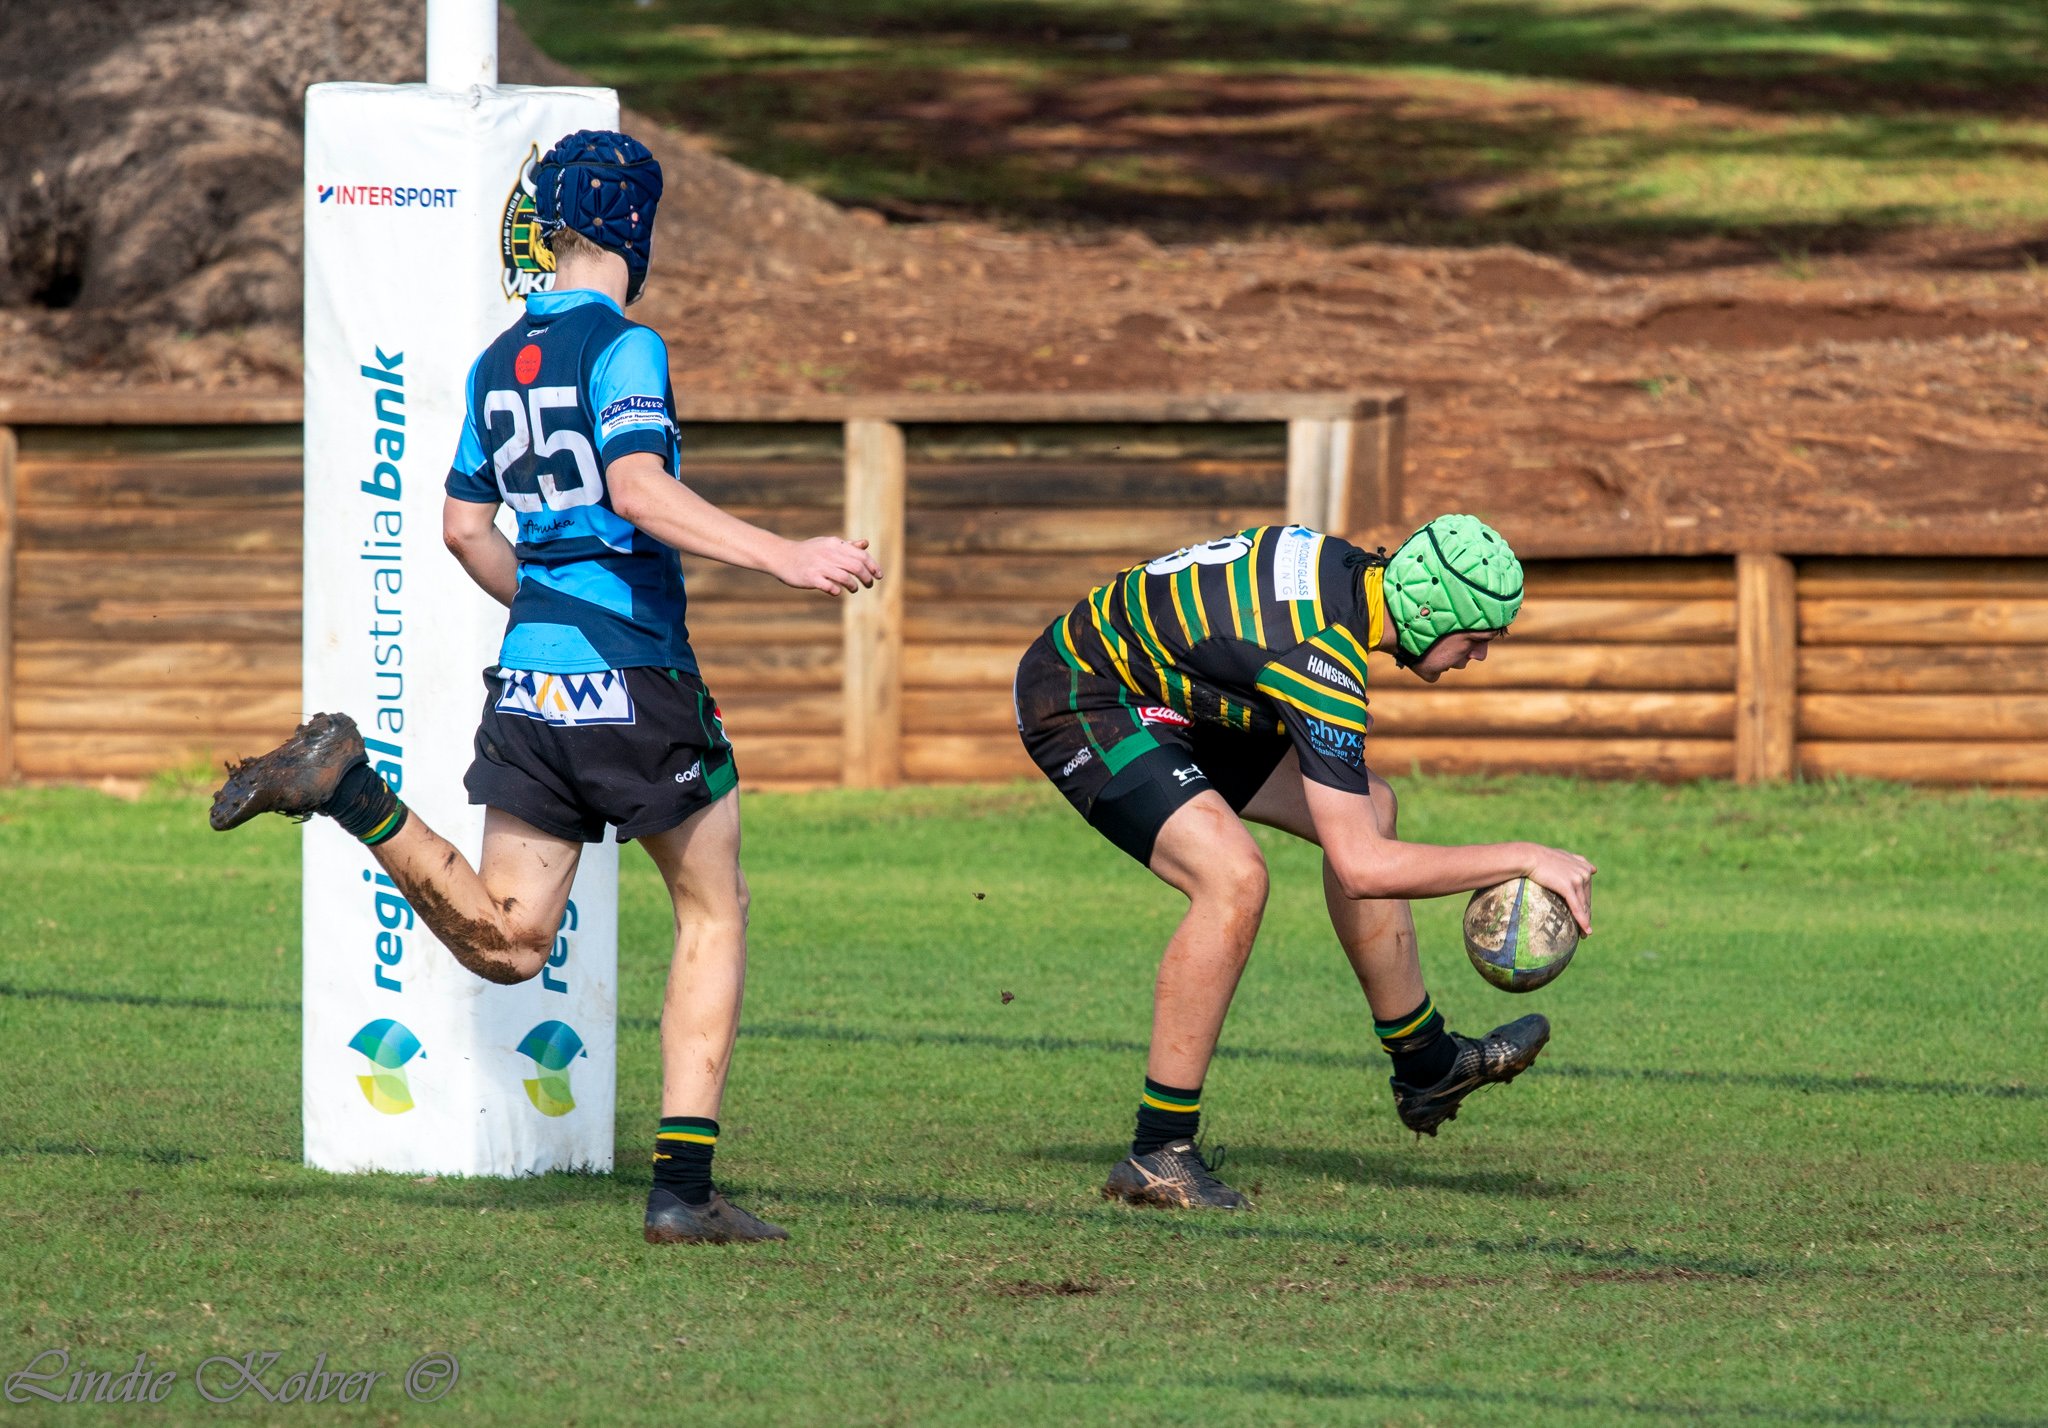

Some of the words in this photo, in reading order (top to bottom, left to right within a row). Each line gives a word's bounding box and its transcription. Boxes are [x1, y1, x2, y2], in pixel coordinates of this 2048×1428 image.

[336, 185, 458, 208] INTERSPORT
[502, 267, 557, 298] VIKI
[361, 344, 406, 501] bank
[483, 385, 604, 513] 25
[361, 511, 404, 734] australia
